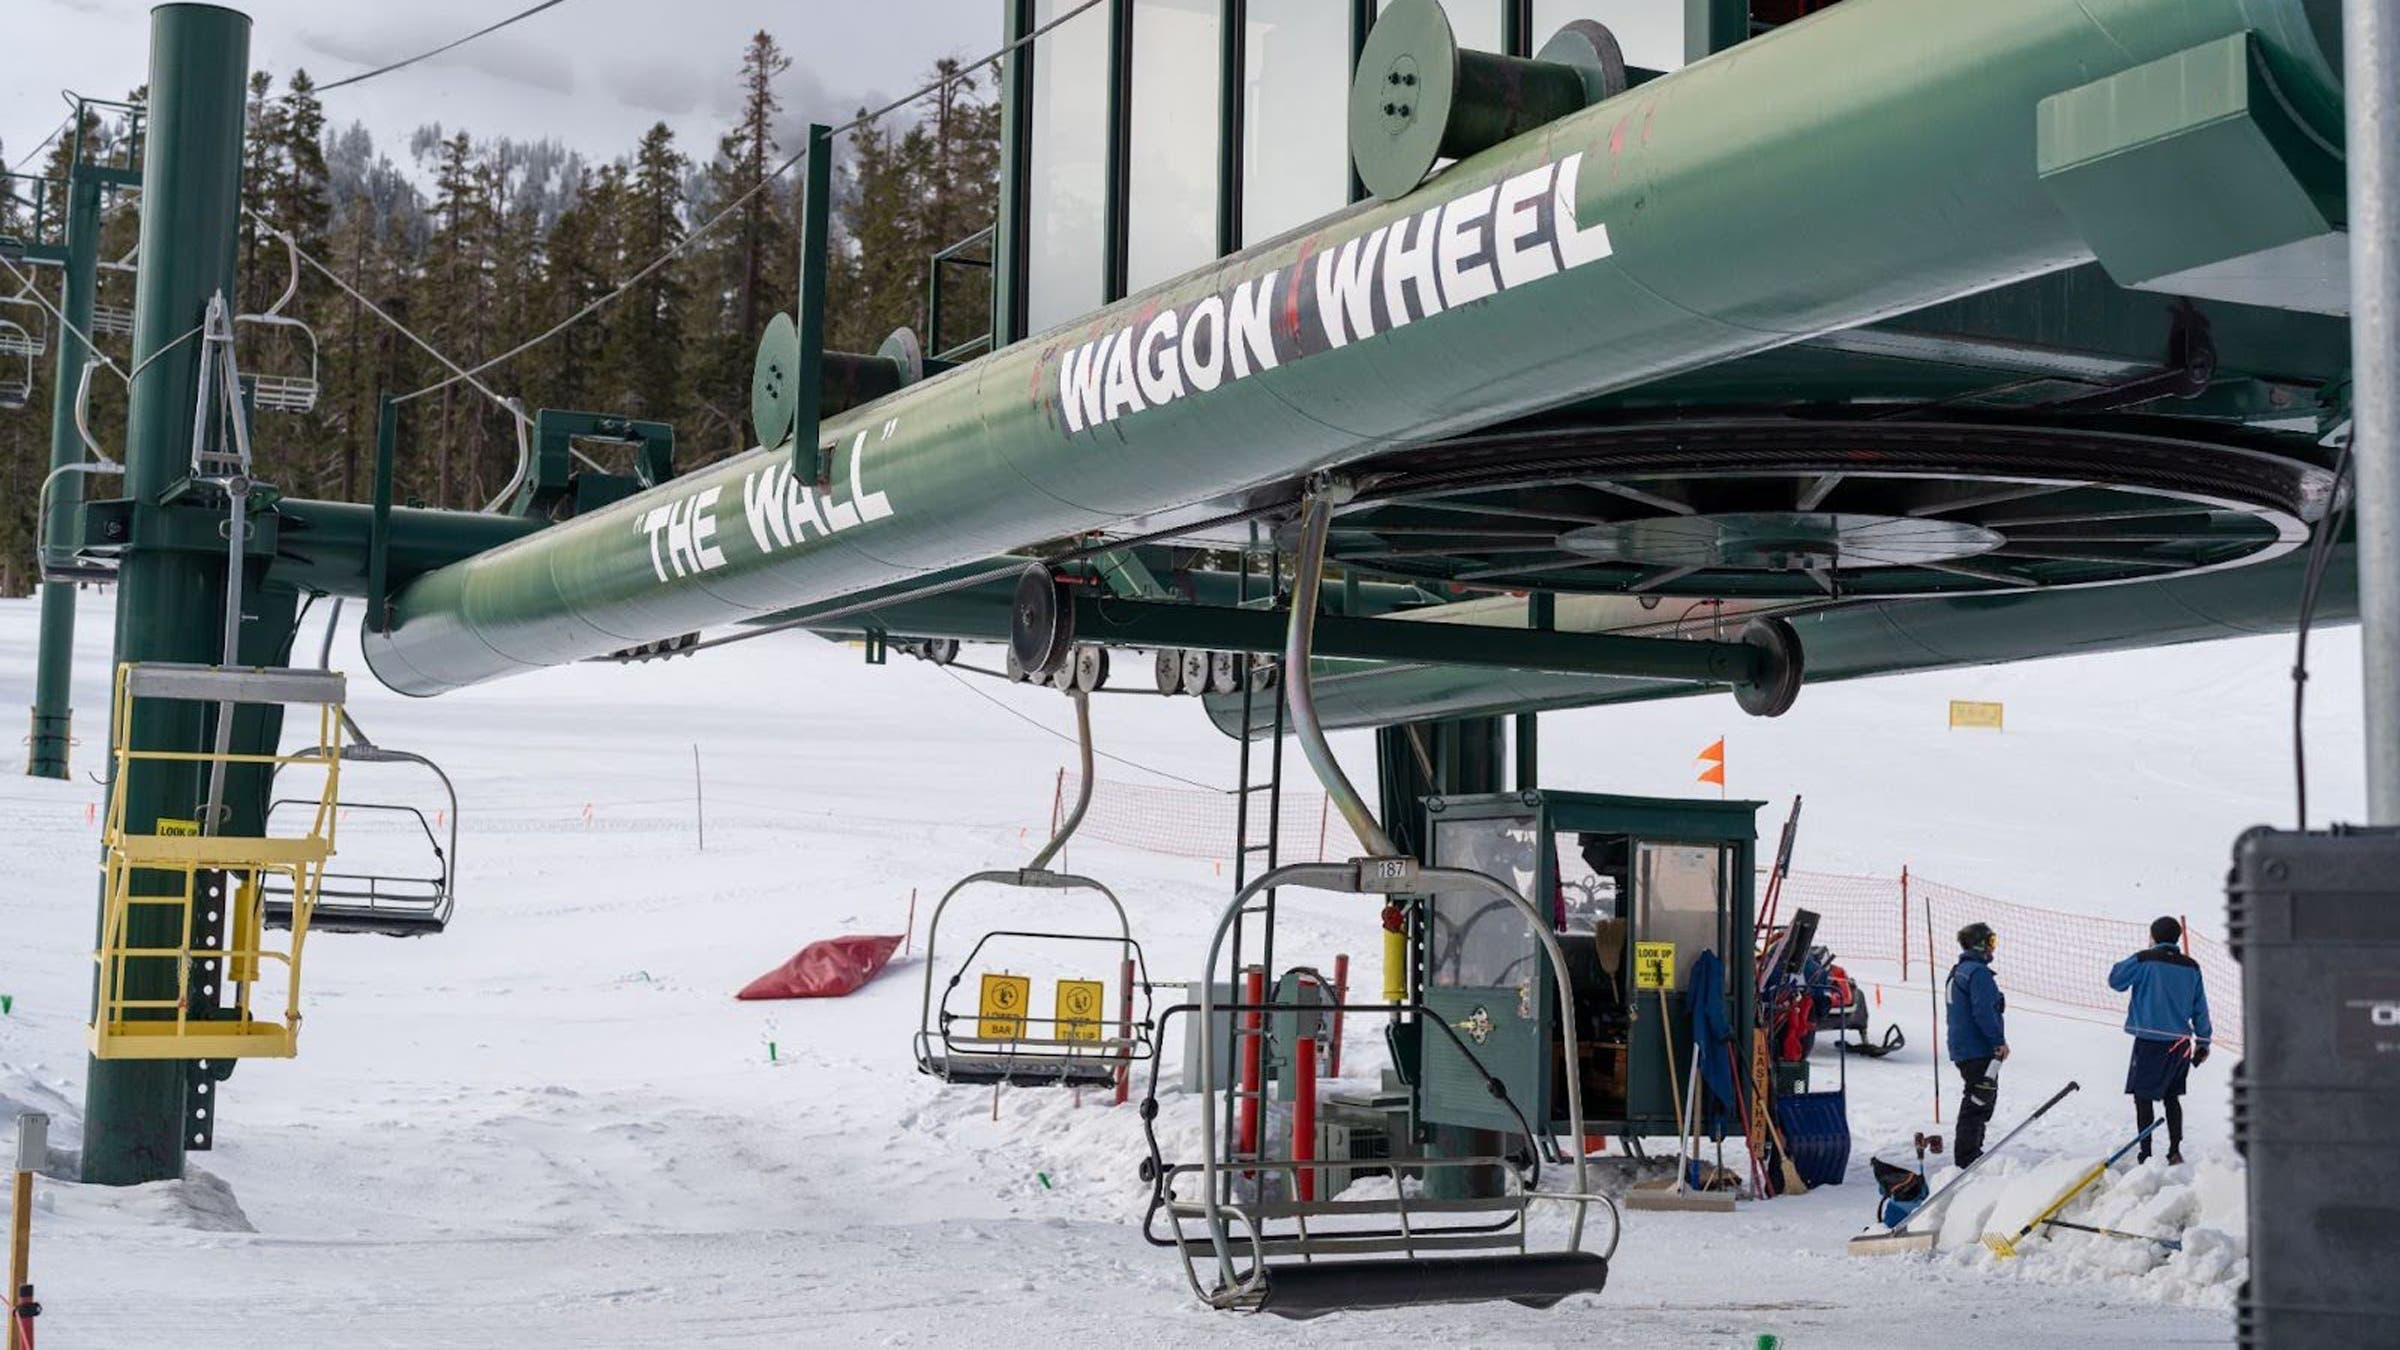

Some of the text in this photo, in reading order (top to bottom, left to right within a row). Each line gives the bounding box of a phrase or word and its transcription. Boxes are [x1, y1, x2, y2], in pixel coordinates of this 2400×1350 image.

[1059, 151, 1613, 433] WAGON WHEEL
[160, 825, 186, 837] LOOK
[1379, 861, 1403, 877] 187
[1638, 948, 1673, 959] LOOK UP
[991, 1025, 1012, 1035] BAR
[1756, 1045, 1767, 1089] LAST
